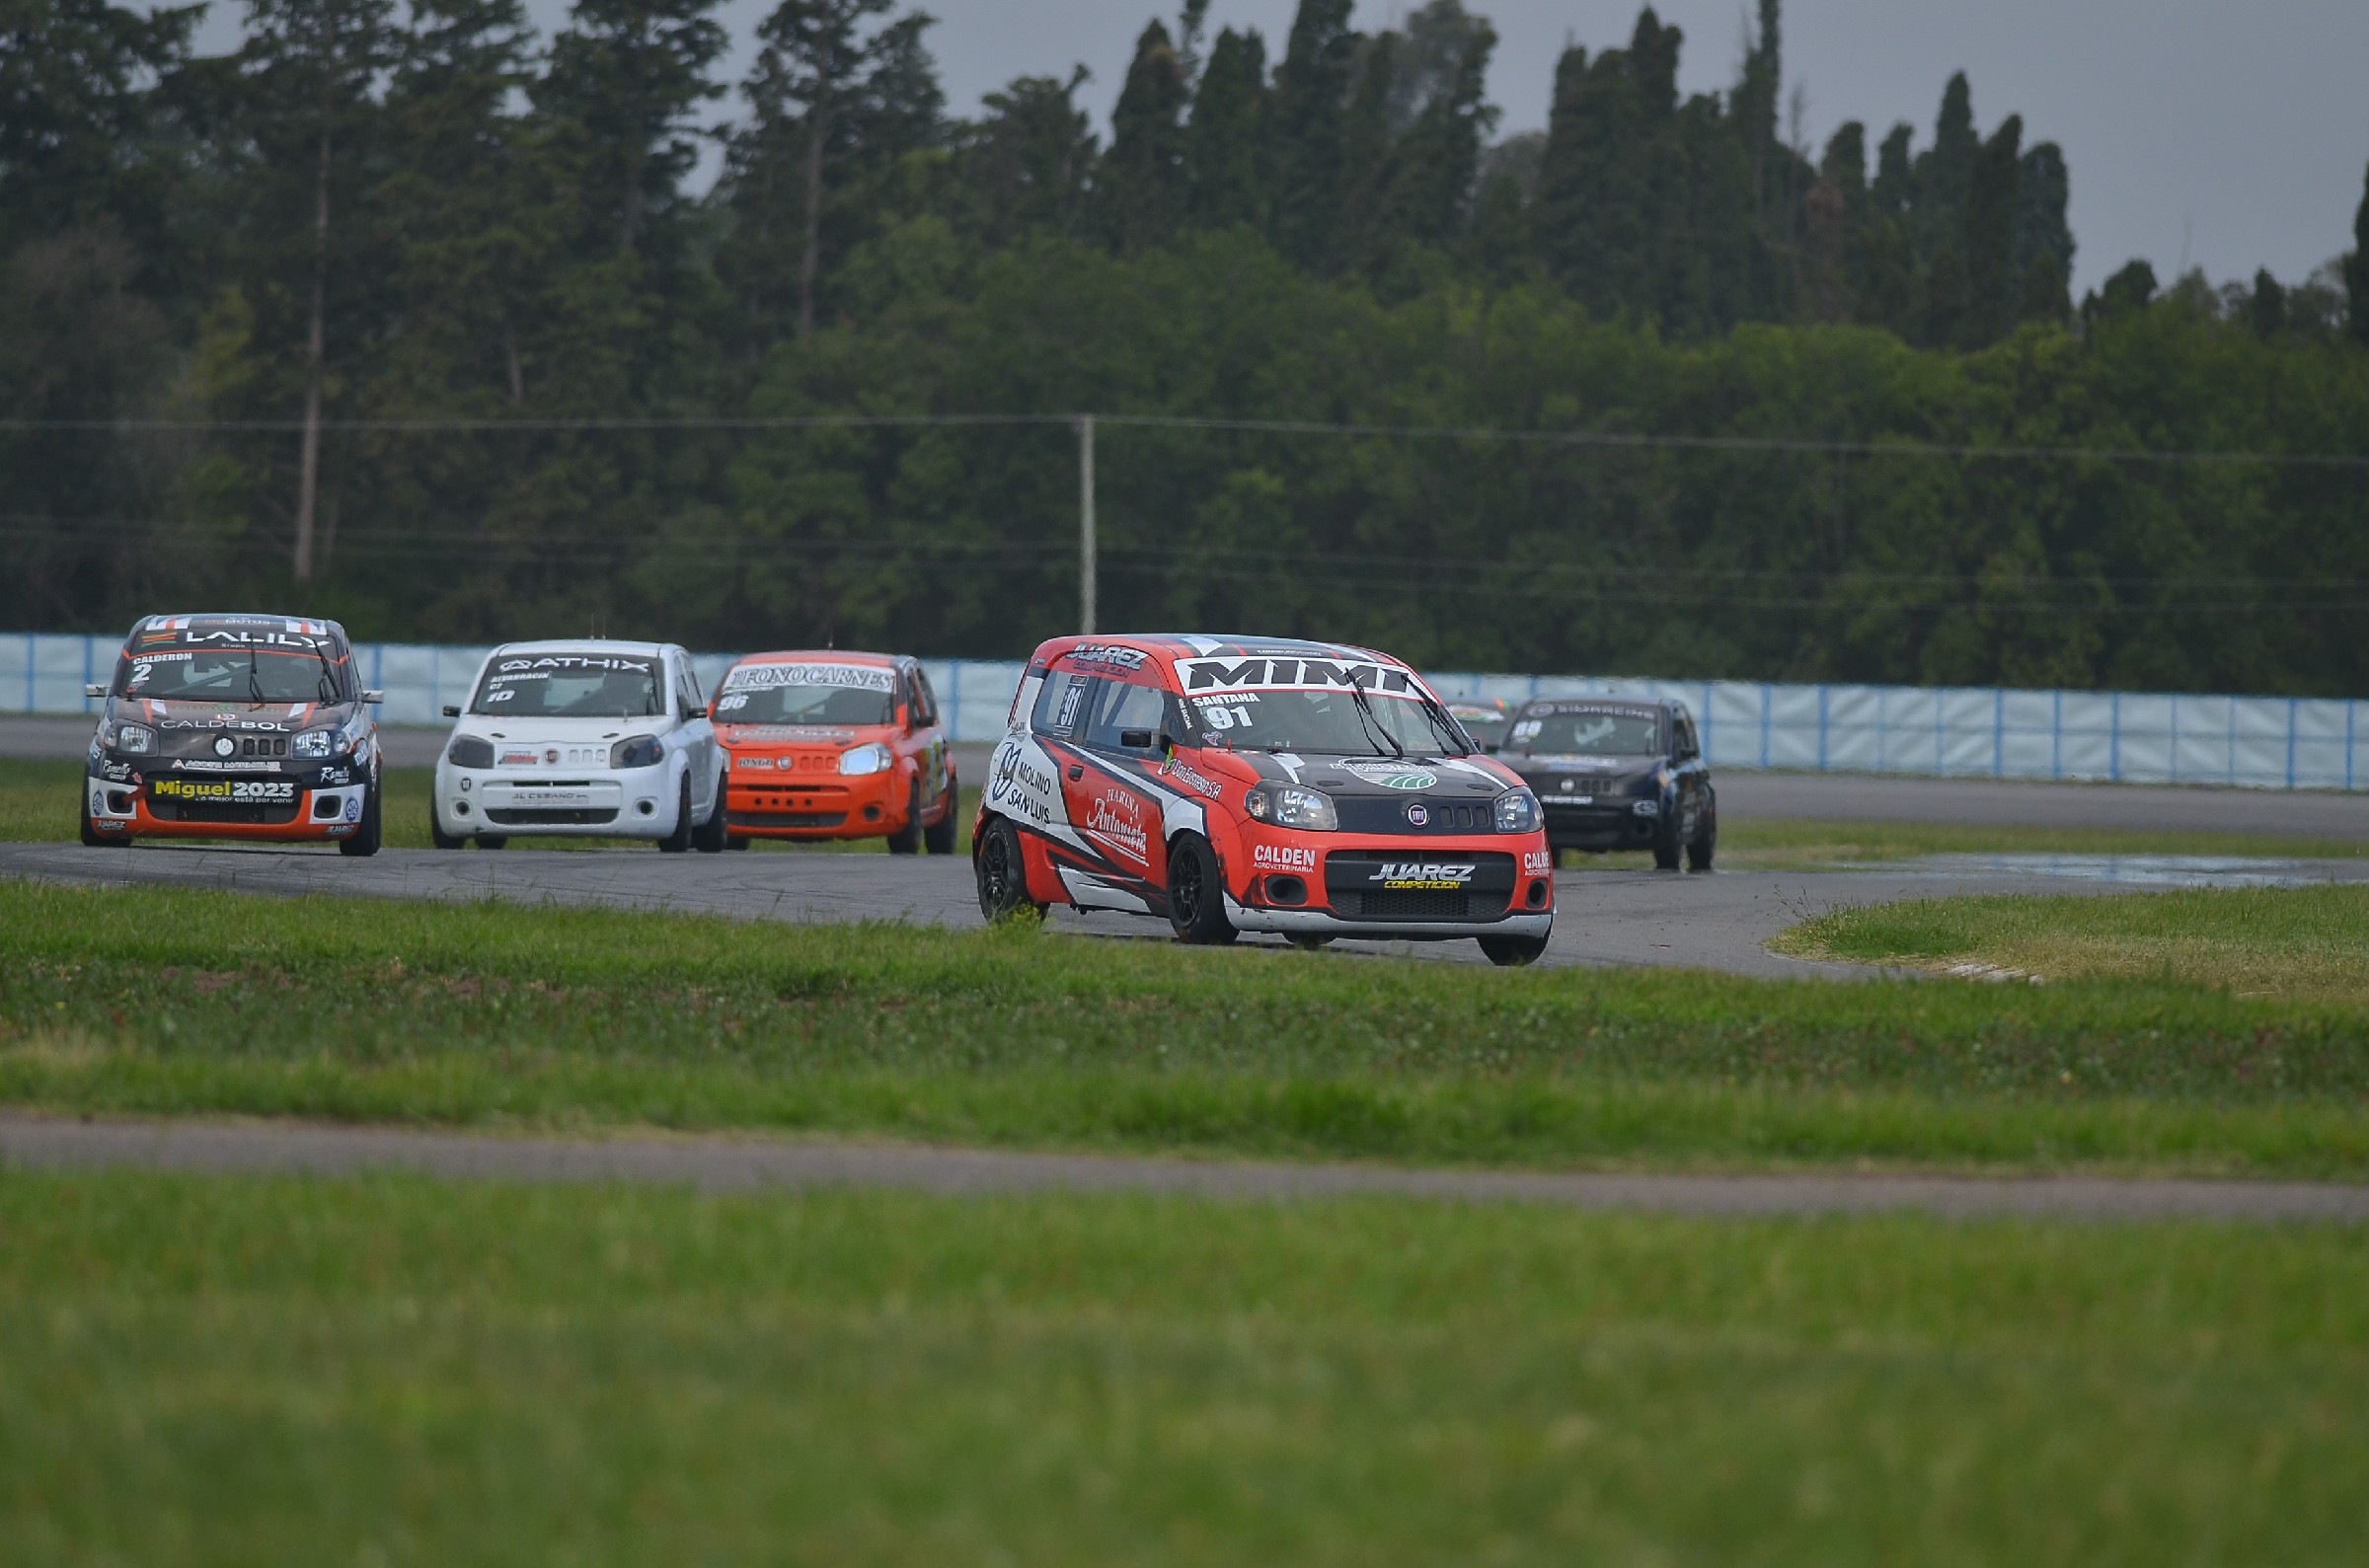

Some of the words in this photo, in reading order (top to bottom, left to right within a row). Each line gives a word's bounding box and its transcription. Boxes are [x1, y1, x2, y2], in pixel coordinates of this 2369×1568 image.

[133, 652, 192, 665] CALDERON
[1066, 642, 1149, 670] JUAREZ
[131, 664, 152, 683] 2
[1187, 659, 1409, 692] MIMI
[487, 690, 515, 703] 10
[717, 694, 749, 711] 96
[1191, 693, 1261, 708] SANTANA
[161, 720, 291, 732] CALDEBOL
[1206, 706, 1254, 730] 91
[1018, 761, 1051, 796] MOLINO
[155, 780, 231, 798] Miguel
[232, 782, 295, 797] 2023
[1007, 788, 1031, 814] SAN
[1030, 798, 1051, 825] LUIS
[1106, 788, 1140, 820] HARINA
[1254, 844, 1316, 866] CALDEN
[1368, 863, 1476, 882] JUAREZ
[1384, 880, 1461, 889] COMPETICION
